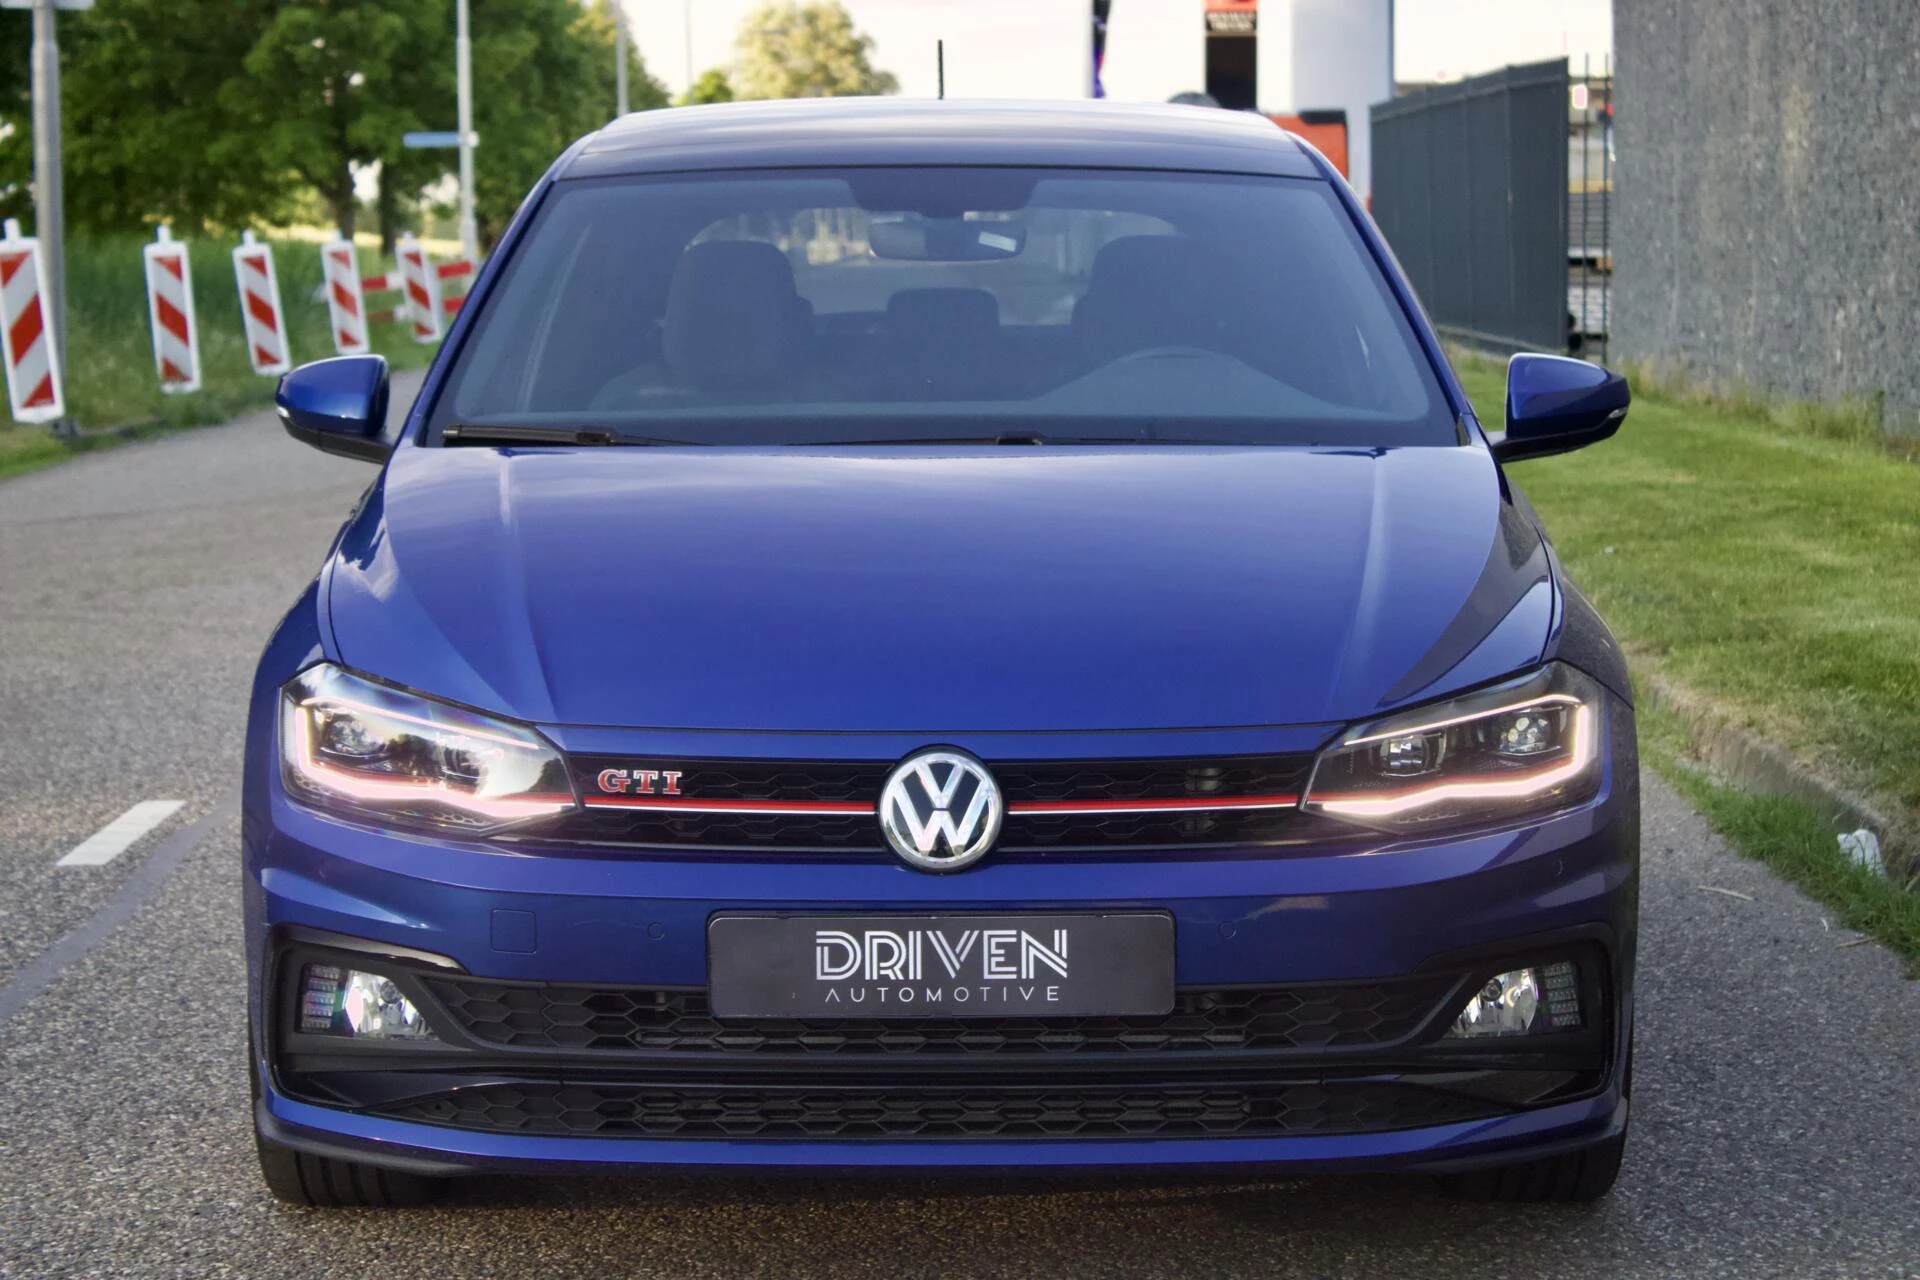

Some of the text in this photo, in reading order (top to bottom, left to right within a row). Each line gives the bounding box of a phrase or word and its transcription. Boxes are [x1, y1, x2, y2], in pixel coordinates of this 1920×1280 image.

[598, 769, 682, 794] GTI
[816, 929, 1068, 980] DRIVEN
[825, 986, 1060, 1003] AUTOMOTIVE
